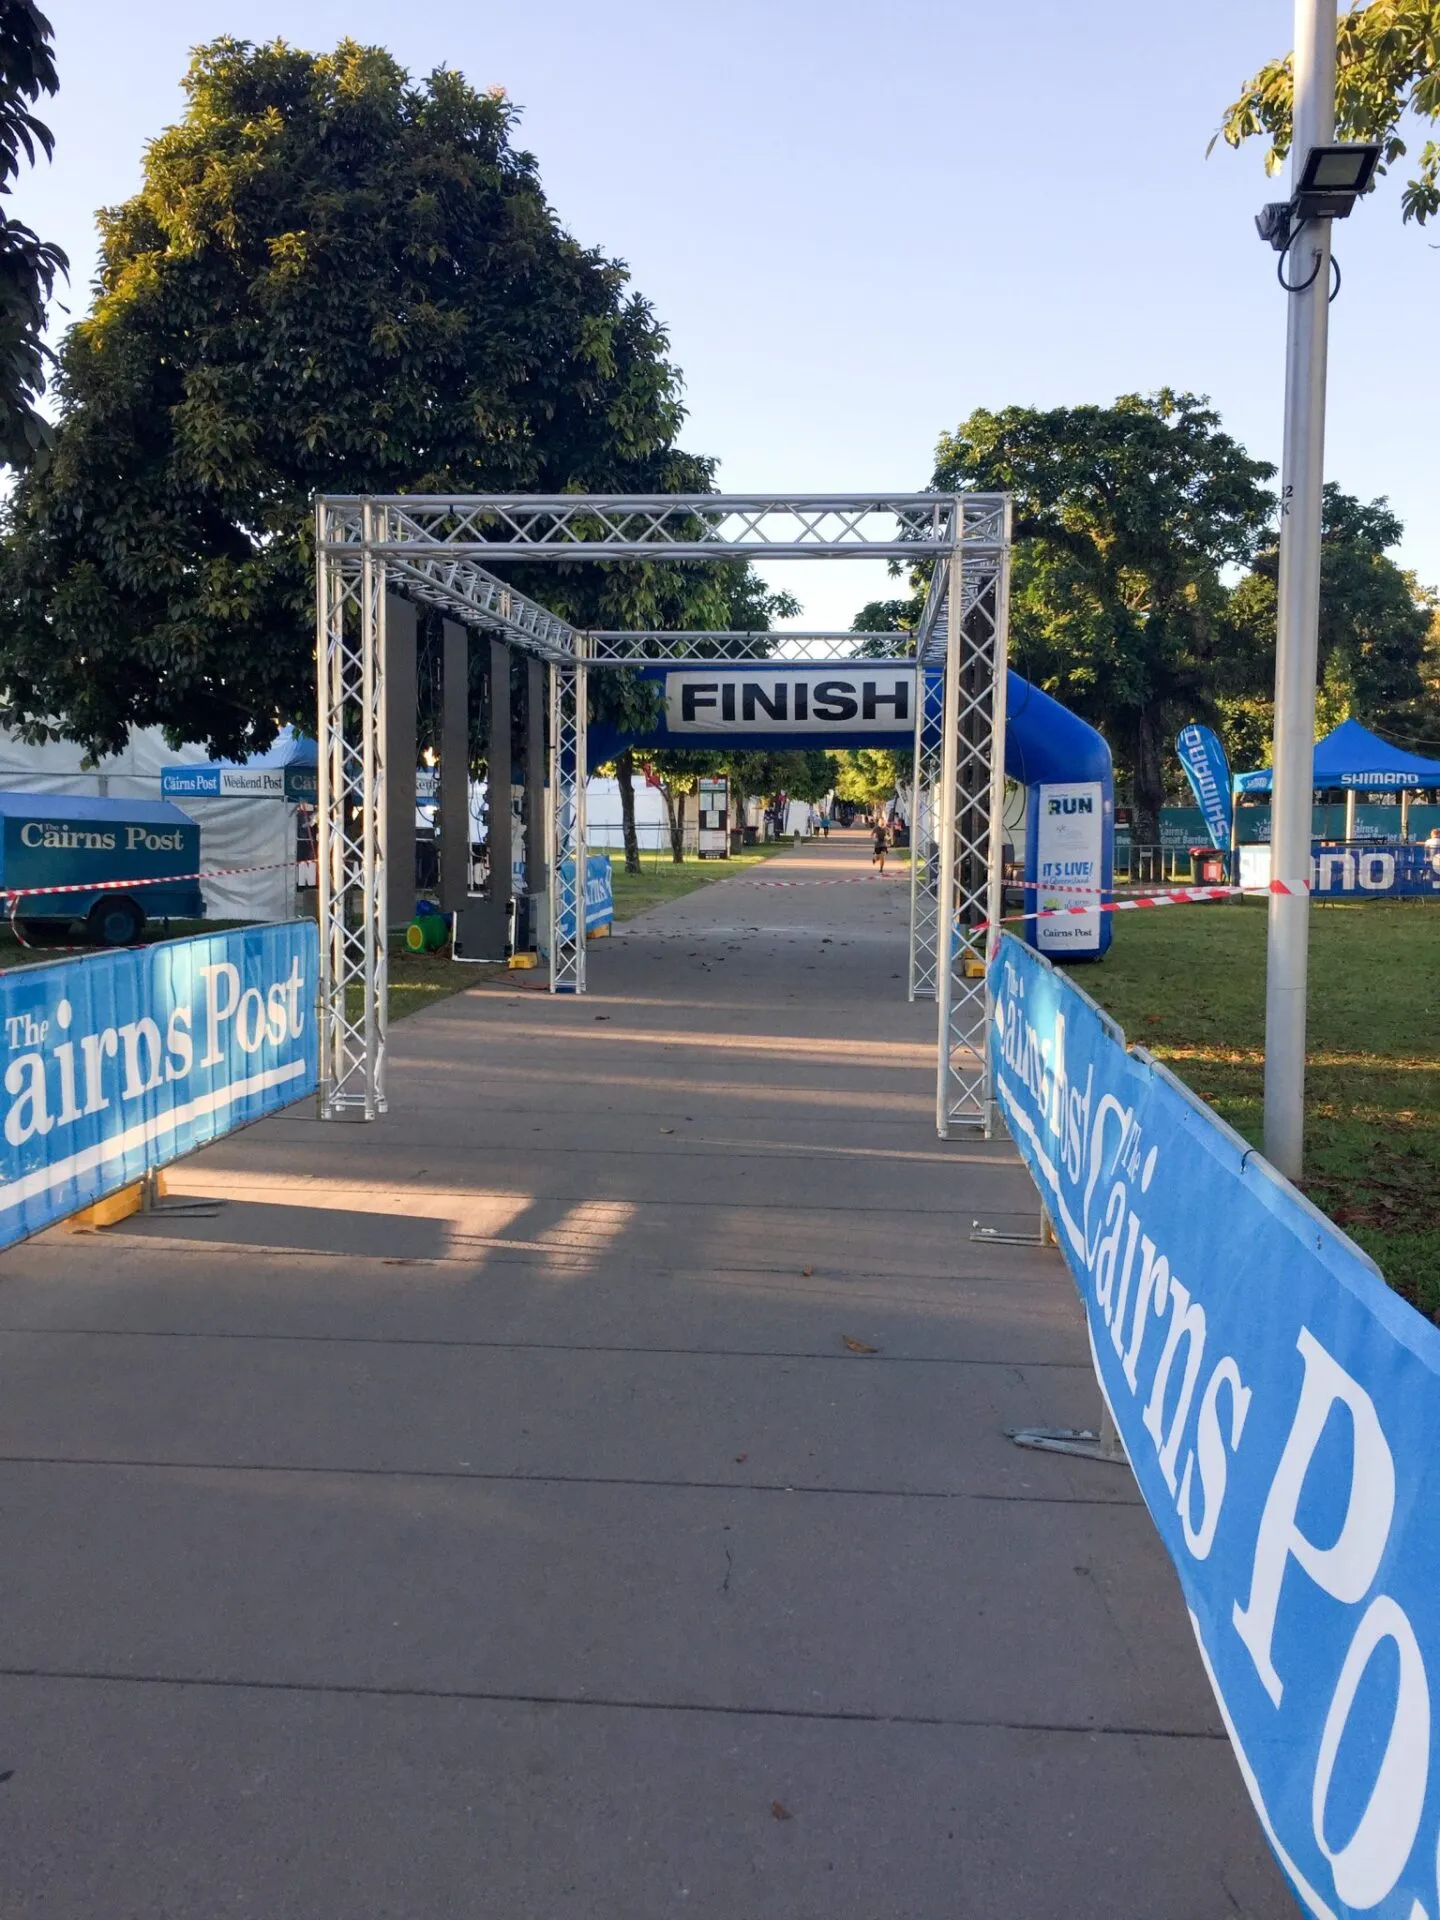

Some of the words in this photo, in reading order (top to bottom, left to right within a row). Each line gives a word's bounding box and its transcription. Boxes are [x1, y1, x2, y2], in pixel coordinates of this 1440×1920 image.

[682, 681, 909, 721] FINISH
[164, 775, 195, 790] Cairns
[196, 776, 217, 790] Post
[224, 775, 261, 789] Weekend
[264, 775, 283, 789] Post
[1340, 773, 1420, 785] SHIMANO
[1048, 797, 1093, 815] RUN
[20, 822, 115, 850] Cairns
[125, 827, 184, 851] Post
[1043, 862, 1062, 877] ITS
[1043, 928, 1073, 938] Cairns
[1074, 928, 1093, 937] Post
[5, 1014, 49, 1050] The
[5, 999, 194, 1147] airns
[200, 955, 305, 1068] Post
[1084, 1093, 1252, 1561] Cairns
[1232, 1325, 1440, 1920] Po
